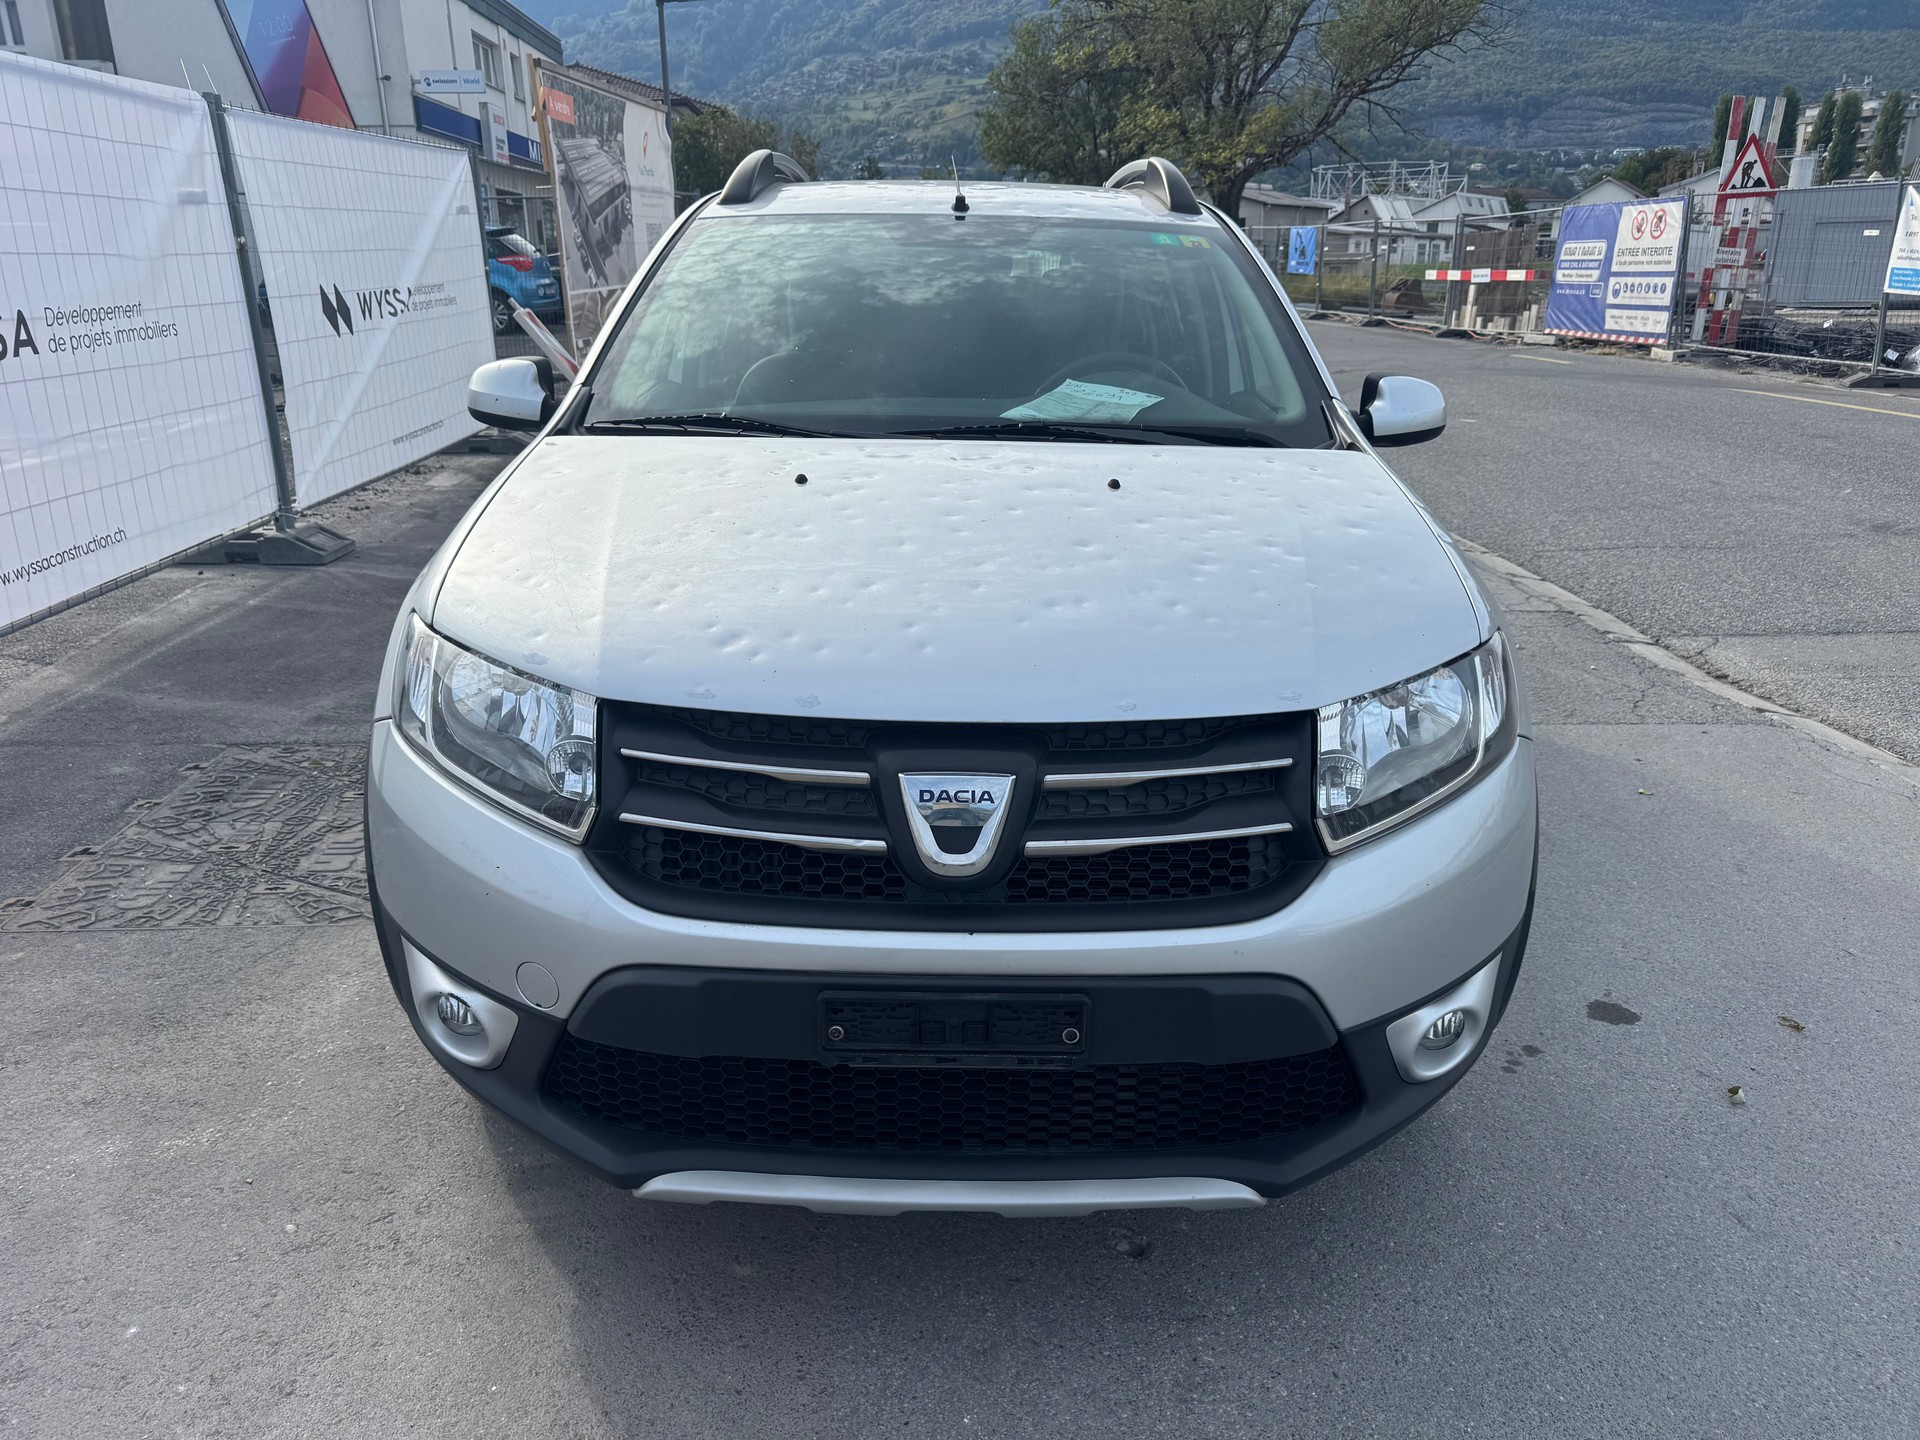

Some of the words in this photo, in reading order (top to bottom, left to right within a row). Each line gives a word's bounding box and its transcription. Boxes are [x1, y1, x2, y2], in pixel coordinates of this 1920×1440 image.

[554, 102, 571, 116] vendre
[1617, 246, 1640, 257] ENTRÉE
[1641, 246, 1673, 257] INTERDITE
[44, 301, 142, 327] Développement
[48, 332, 66, 353] de
[70, 329, 112, 355] projets
[113, 320, 179, 345] immobiliers
[919, 789, 995, 804] DACIA
